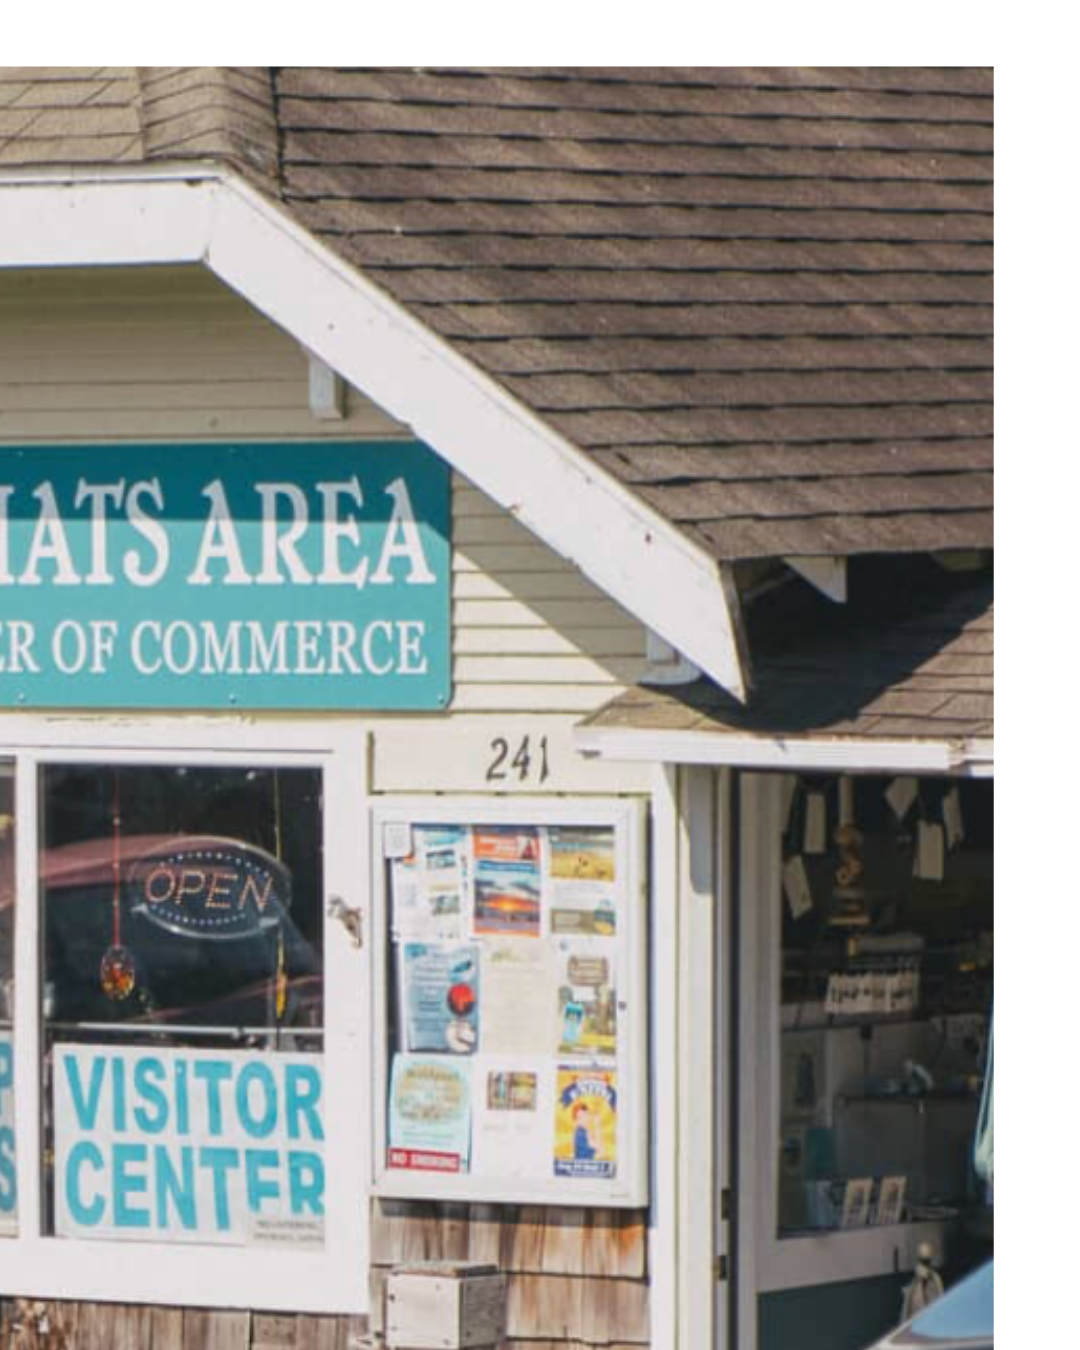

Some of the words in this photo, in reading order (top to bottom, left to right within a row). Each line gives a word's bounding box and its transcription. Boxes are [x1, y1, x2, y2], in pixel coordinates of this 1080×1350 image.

[188, 475, 437, 591] AREA
[51, 618, 119, 675] OF
[130, 618, 429, 676] COMMERCE
[486, 734, 549, 783] 241
[145, 866, 274, 913] OPEN
[63, 1053, 325, 1141] VISITOR
